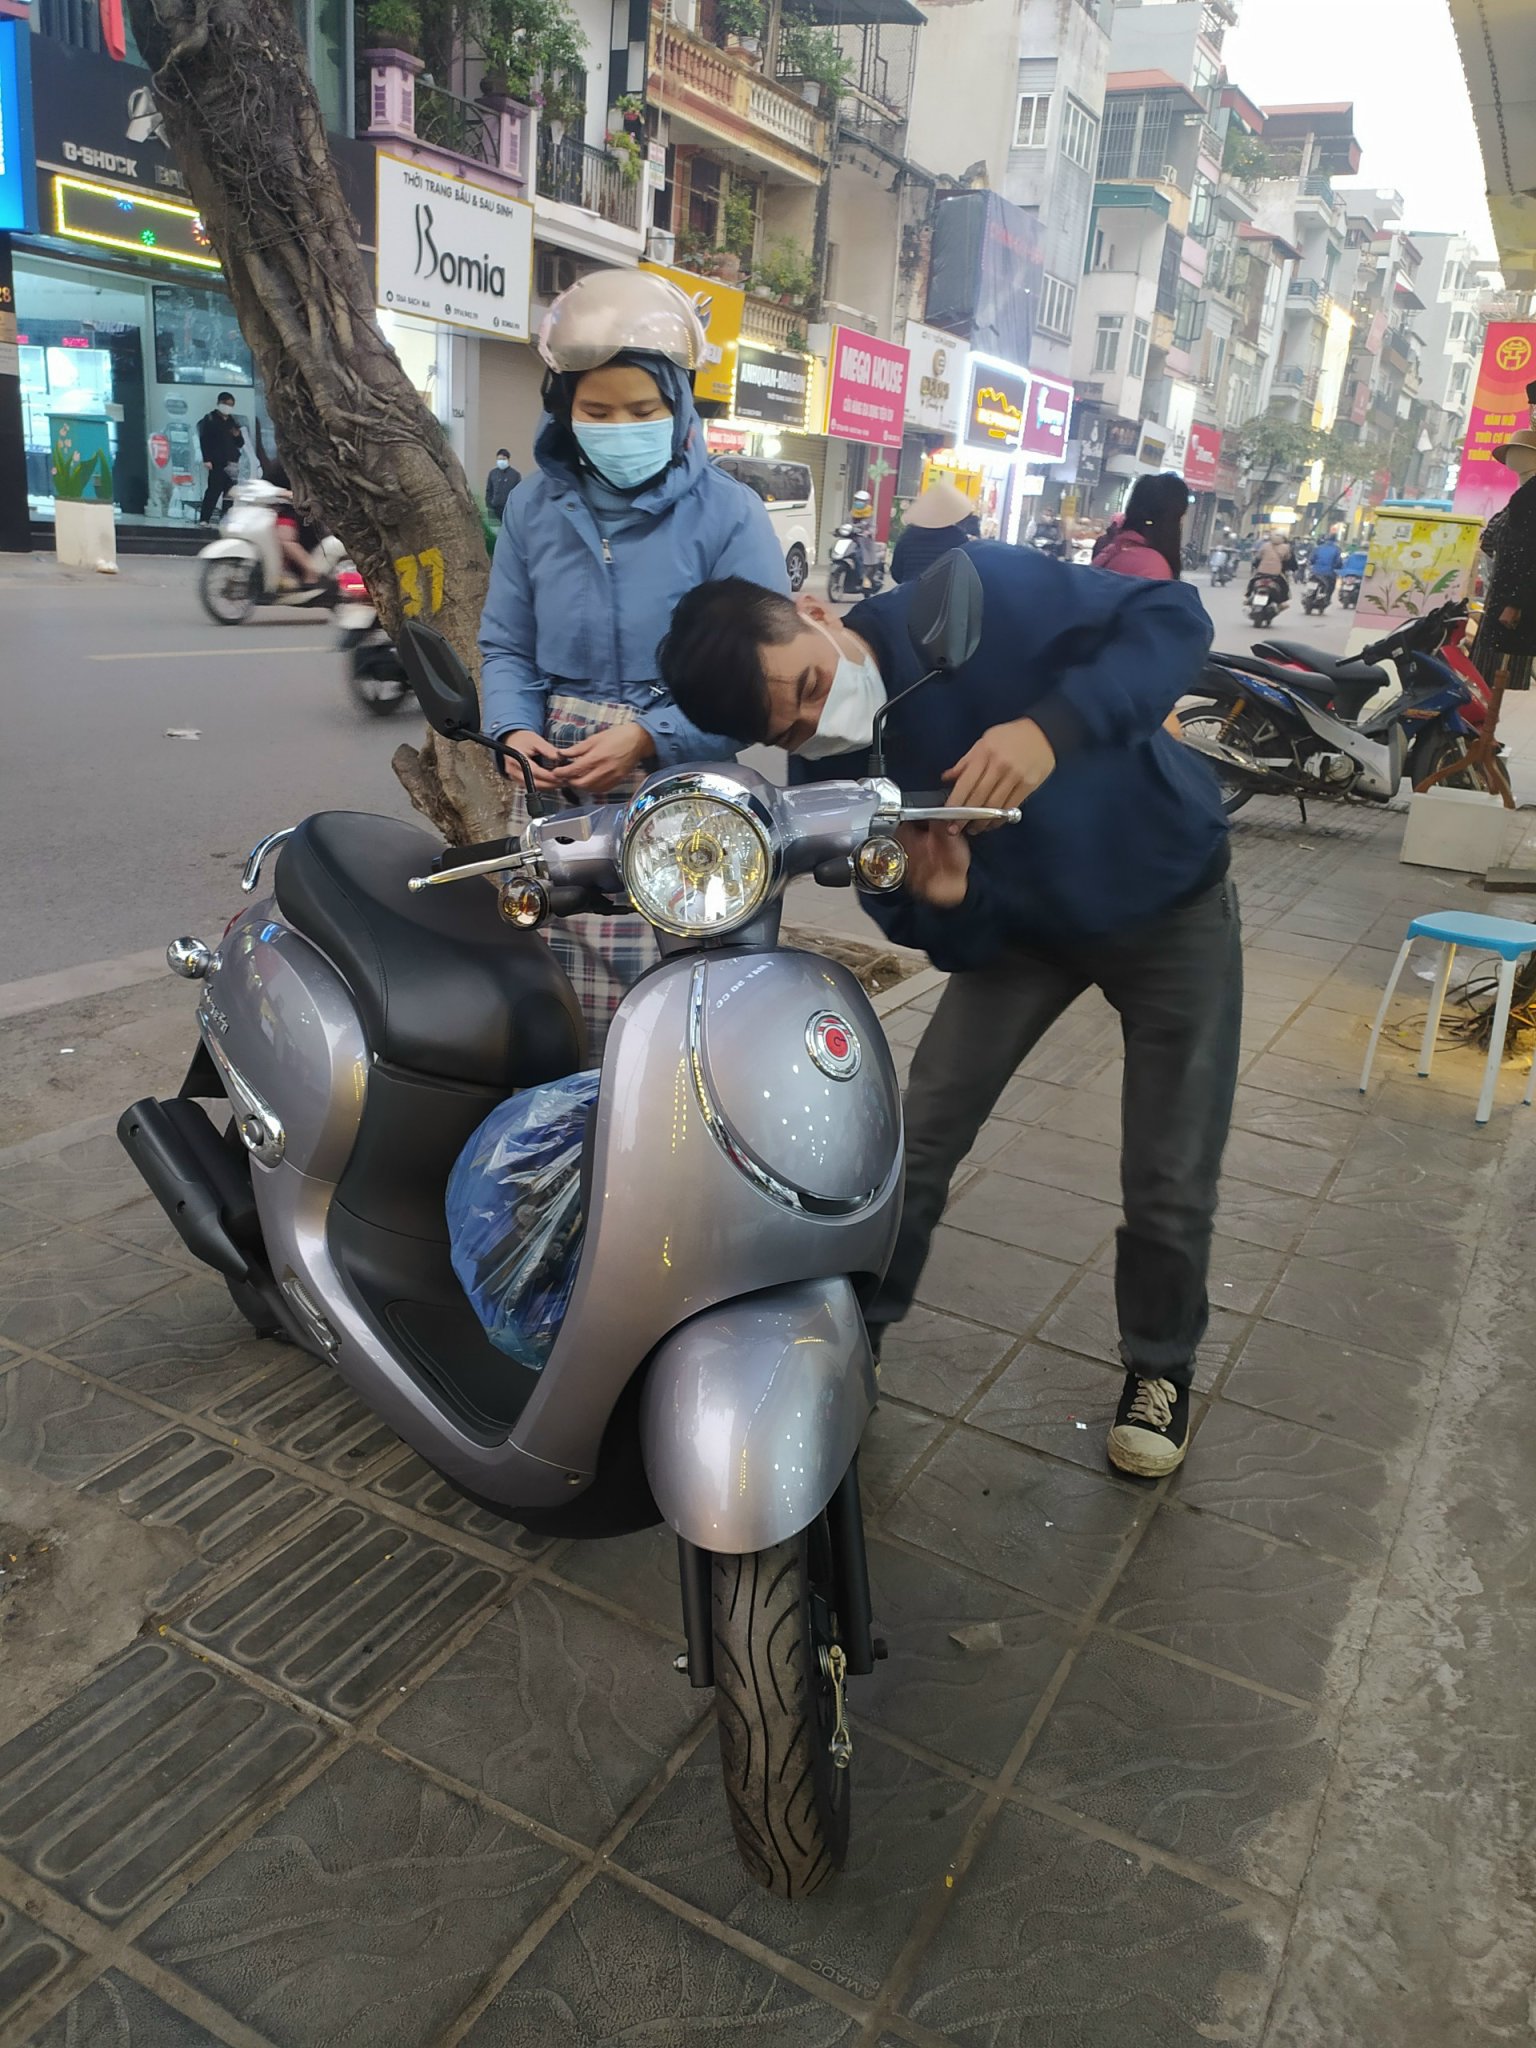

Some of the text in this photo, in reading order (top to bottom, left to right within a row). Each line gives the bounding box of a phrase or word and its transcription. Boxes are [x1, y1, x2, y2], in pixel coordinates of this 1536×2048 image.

[62, 141, 138, 178] G-SHOCK
[425, 179, 453, 199] TRANG
[471, 194, 478, 207] &
[479, 197, 495, 212] SAU
[495, 204, 514, 219] SINH
[840, 345, 871, 386] MEGA
[871, 355, 905, 394] HOUSE
[393, 546, 445, 618] 37
